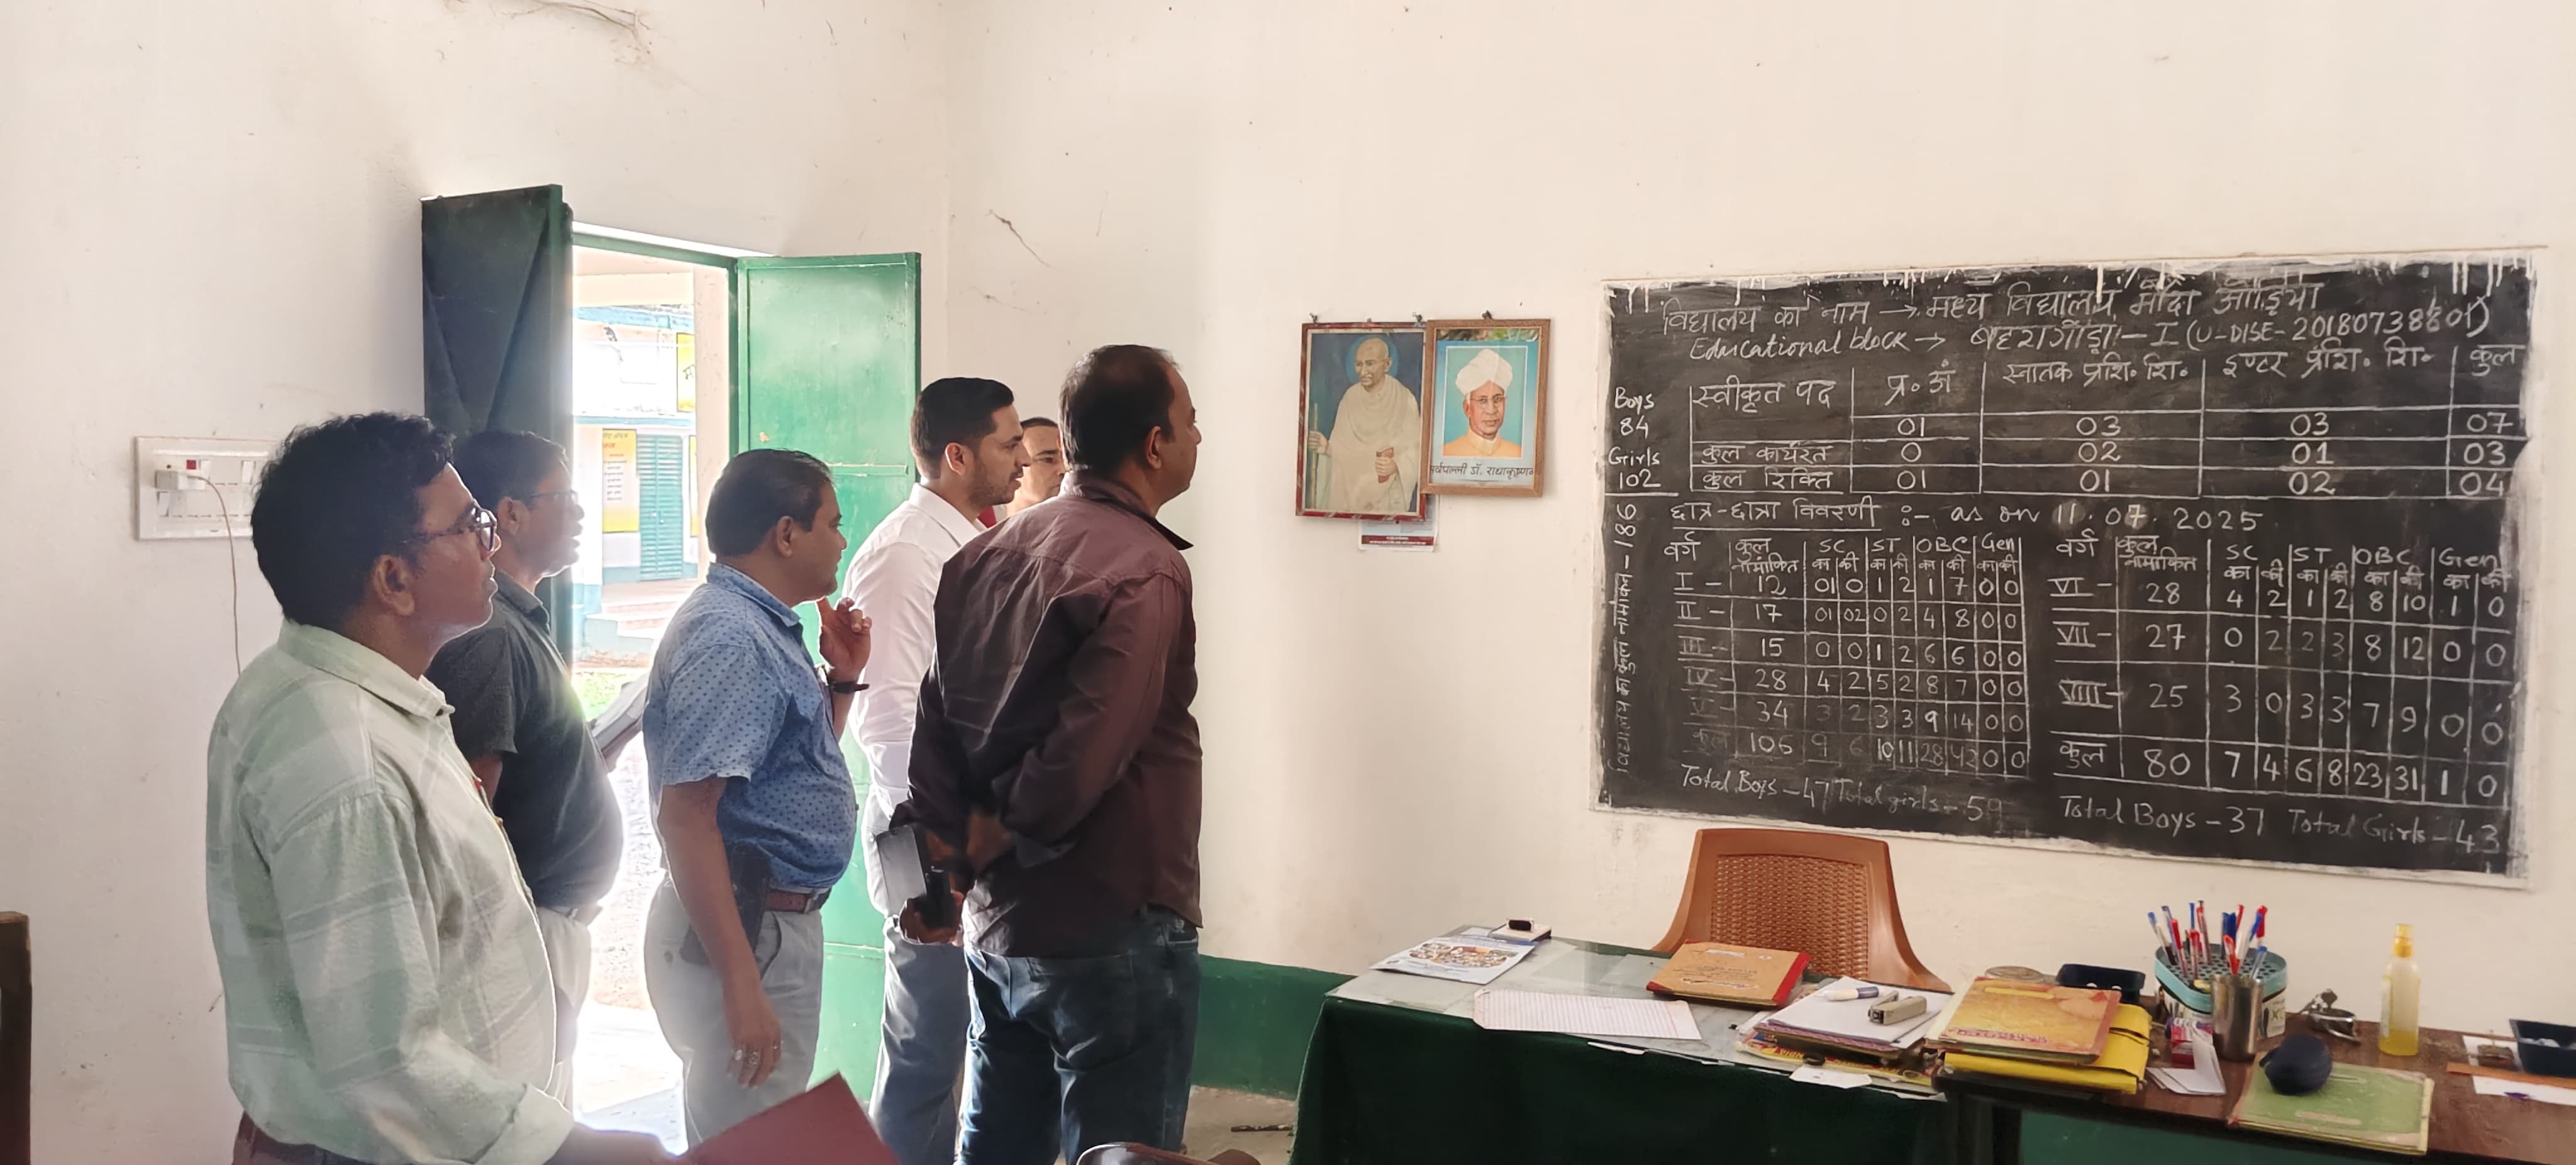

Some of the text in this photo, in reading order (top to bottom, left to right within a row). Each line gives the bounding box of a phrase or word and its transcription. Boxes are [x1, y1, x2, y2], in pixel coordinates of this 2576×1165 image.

[1662, 298, 1760, 335] विद्यालय
[1774, 306, 1809, 328] का
[1822, 301, 1870, 324] नाम
[2007, 281, 2122, 316] विद्यालय
[1850, 326, 1909, 352] block
[2470, 344, 2526, 377] कुल
[1614, 387, 1654, 410] Boys
[1693, 375, 1785, 413] स्वीकृत
[1796, 380, 1836, 409] पद
[1620, 412, 2513, 440] 84 01 03 03 07
[1608, 446, 1660, 468] Girls
[1702, 444, 1746, 464] कुल
[1901, 442, 1921, 463] 0
[2078, 442, 2121, 463] 02
[2291, 442, 2334, 464] 01
[2463, 441, 2506, 465] 03
[1619, 469, 1661, 489] 102
[1702, 469, 1746, 490] कुल
[1896, 469, 1926, 490] 01
[2079, 469, 2110, 493] 01
[2289, 471, 2336, 495] 02
[2459, 472, 2505, 496] 04
[1793, 495, 1882, 527] विवरणी
[1951, 506, 1983, 521] as
[1999, 506, 2040, 522] on
[1663, 531, 1701, 562] वर्ग
[1819, 539, 1845, 553] SC
[1871, 538, 1901, 552] ST
[1917, 536, 1971, 554] OBC
[1982, 532, 2014, 552] Gen
[2056, 528, 2099, 557] वर्ग
[2226, 544, 2258, 560] SC
[2294, 547, 2332, 564] ST
[2355, 546, 2411, 565] OBC
[2438, 547, 2498, 567] Gen
[1758, 575, 1786, 595] 12
[1815, 577, 1835, 594] 01
[1846, 578, 1863, 593] 0
[2146, 582, 2180, 605] 28
[2334, 589, 2349, 609] 2
[2403, 594, 2426, 612] 10
[1756, 603, 1782, 623] 17
[1815, 607, 1832, 622] 01
[1844, 608, 1866, 622] 02
[1874, 606, 1887, 622] 0
[1898, 607, 1912, 622] 2
[1955, 608, 1970, 627] 8
[1762, 637, 1785, 657] 15
[1816, 642, 1829, 657] 0
[1847, 642, 1863, 659] 0
[2146, 623, 2186, 650] 27
[2224, 627, 2243, 647] 0
[2365, 634, 2381, 659] 8
[2403, 636, 2425, 660] 12
[1755, 669, 1787, 691] 28
[1818, 670, 1829, 692] 4
[1848, 672, 1866, 690] 2
[1876, 674, 1889, 690] 5
[1899, 676, 1914, 692] 2
[1927, 676, 1939, 694] 8
[1757, 700, 1788, 728] 34
[1902, 709, 1913, 728] 3
[1924, 710, 1938, 733] 9
[1954, 712, 1974, 733] 14
[2150, 683, 2188, 708] 25
[2224, 684, 2241, 712] 3
[2301, 693, 2314, 718] 3
[2328, 696, 2346, 723] 3
[2363, 703, 2379, 727] 7
[2401, 706, 2416, 732] 9
[1877, 739, 1894, 761] 10
[1681, 763, 1731, 793] Total
[2060, 740, 2418, 791] कुल 80 6 8 23 31
[2059, 795, 2124, 824] Total
[2134, 803, 2196, 837] Boys
[2289, 808, 2355, 837] Total
